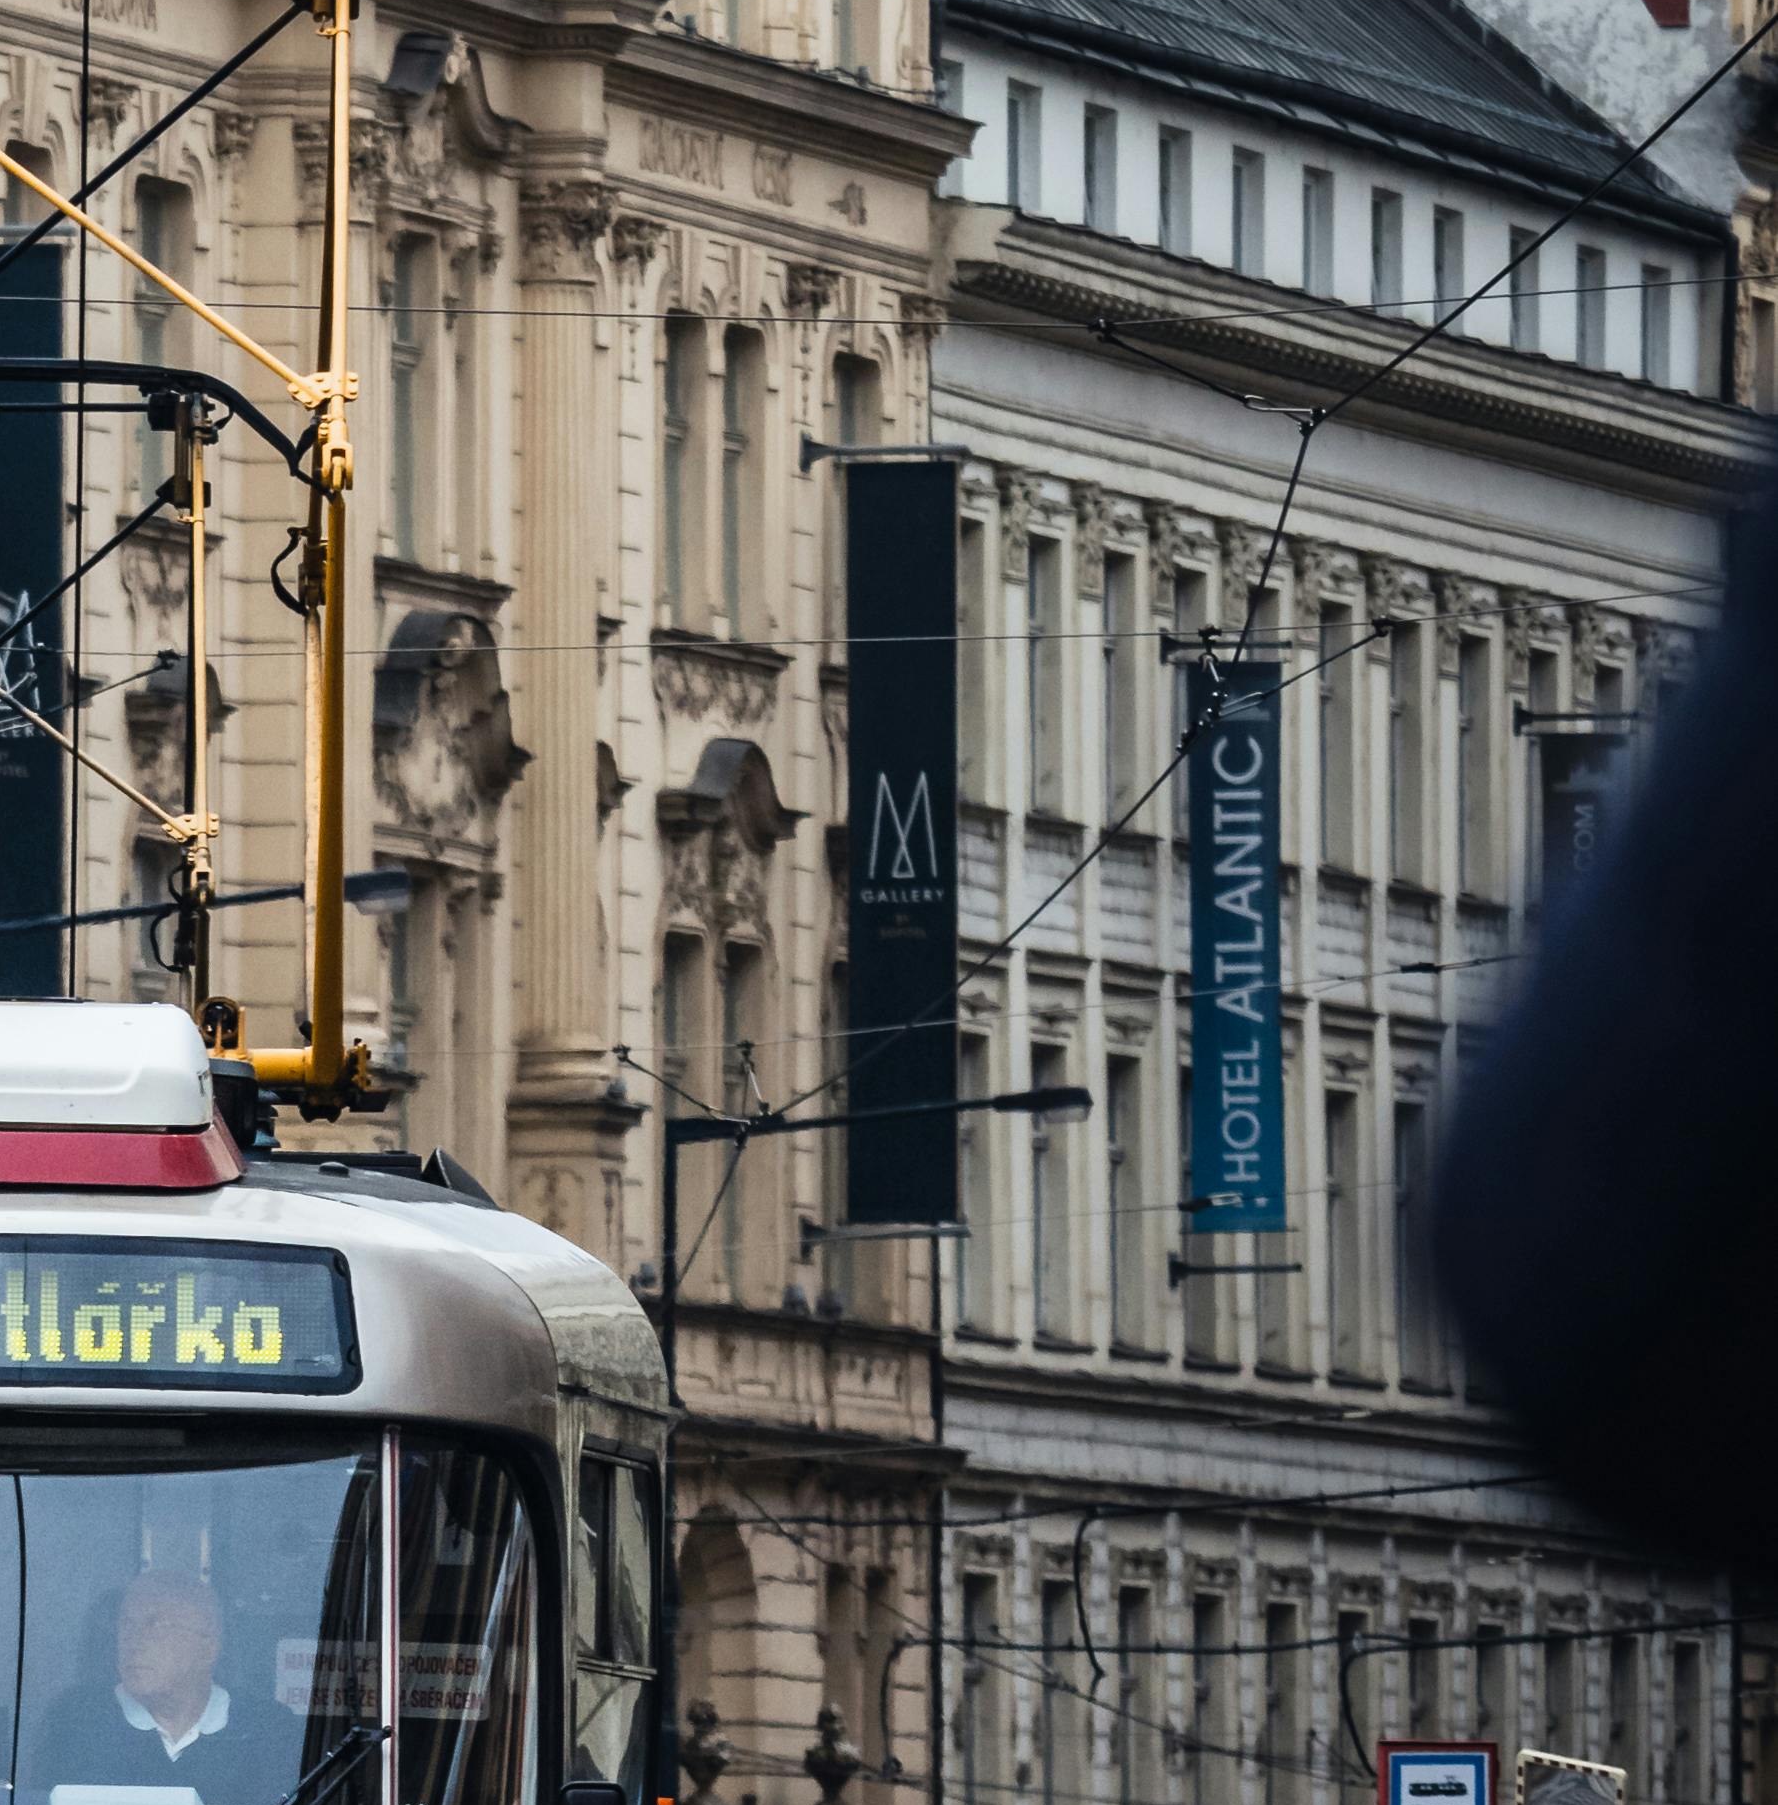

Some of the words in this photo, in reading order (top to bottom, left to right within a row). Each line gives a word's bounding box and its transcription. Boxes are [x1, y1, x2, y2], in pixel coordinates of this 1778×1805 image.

[859, 887, 945, 905] GALLERY
[1212, 735, 1265, 1023] ATLANTIC
[1223, 1029, 1262, 1182] HOTEL
